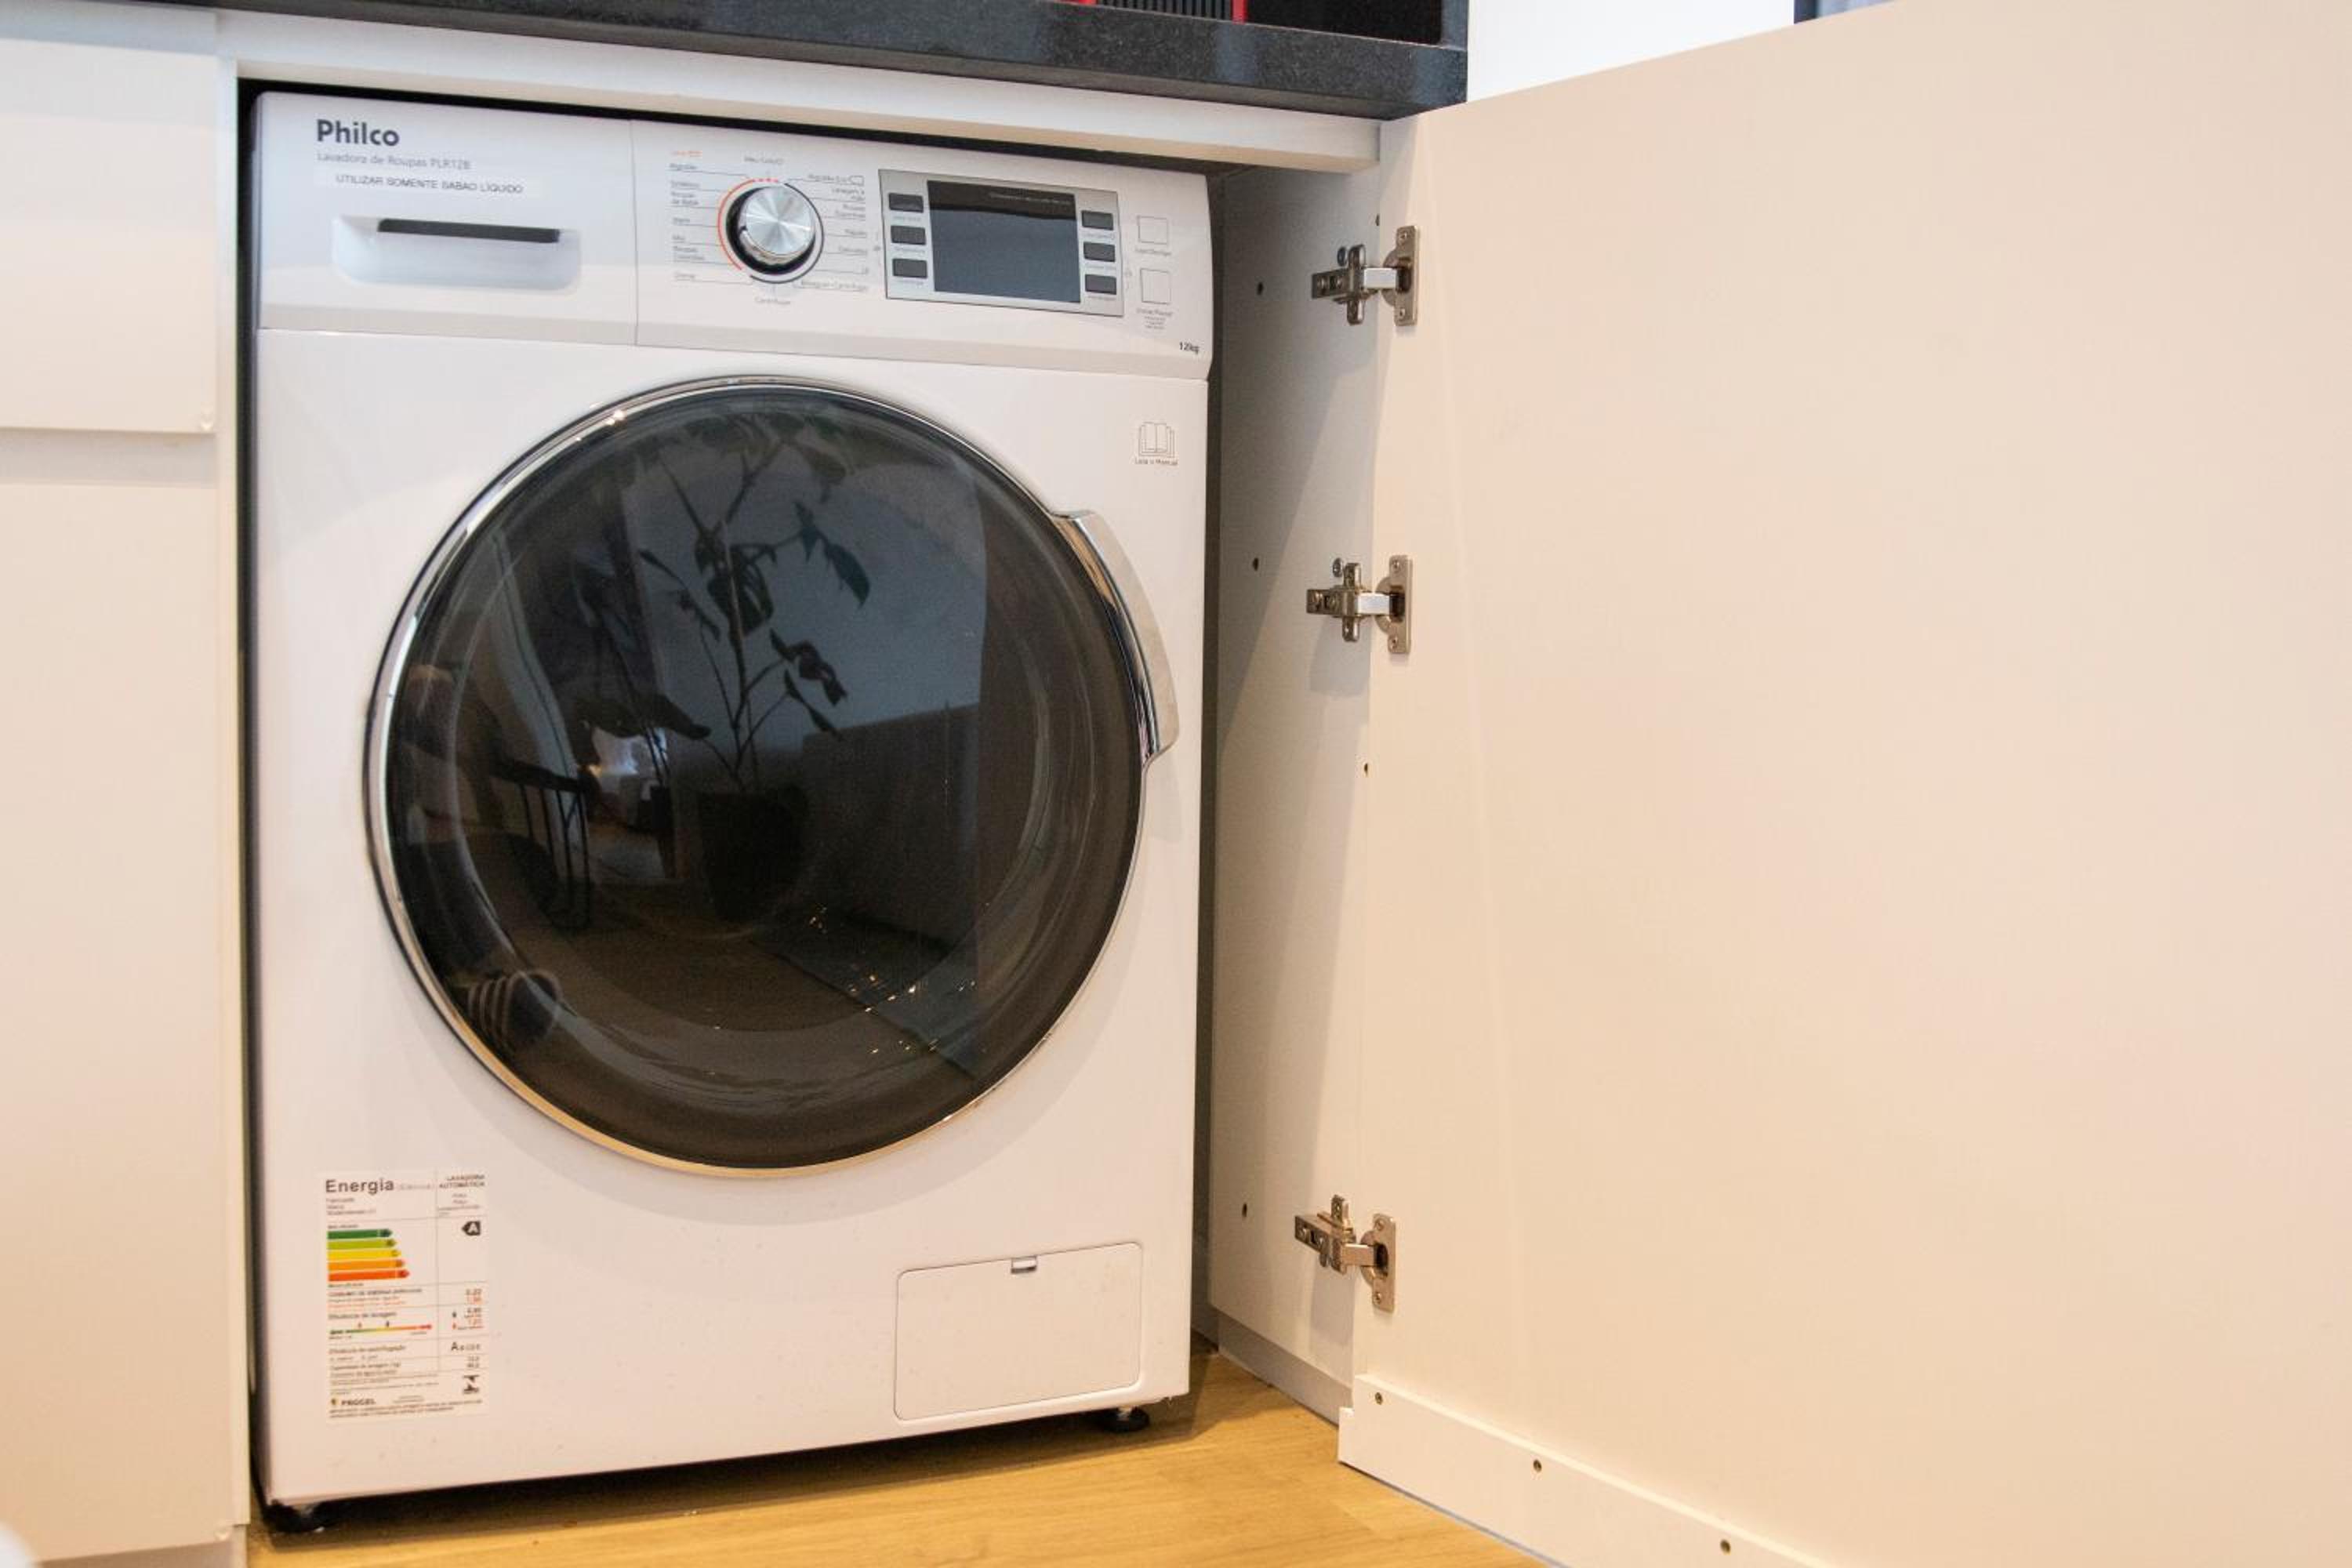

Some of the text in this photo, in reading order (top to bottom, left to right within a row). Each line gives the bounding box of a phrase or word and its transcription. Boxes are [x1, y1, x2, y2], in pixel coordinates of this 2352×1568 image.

[317, 119, 400, 147] Philco
[317, 153, 367, 164] Lavadora
[370, 154, 384, 165] de
[388, 157, 426, 168] Roupas
[336, 174, 383, 186] UTILIZAR
[387, 176, 437, 189] SOMENTE
[1179, 341, 1200, 354] 12kg
[325, 1178, 395, 1195] Energia
